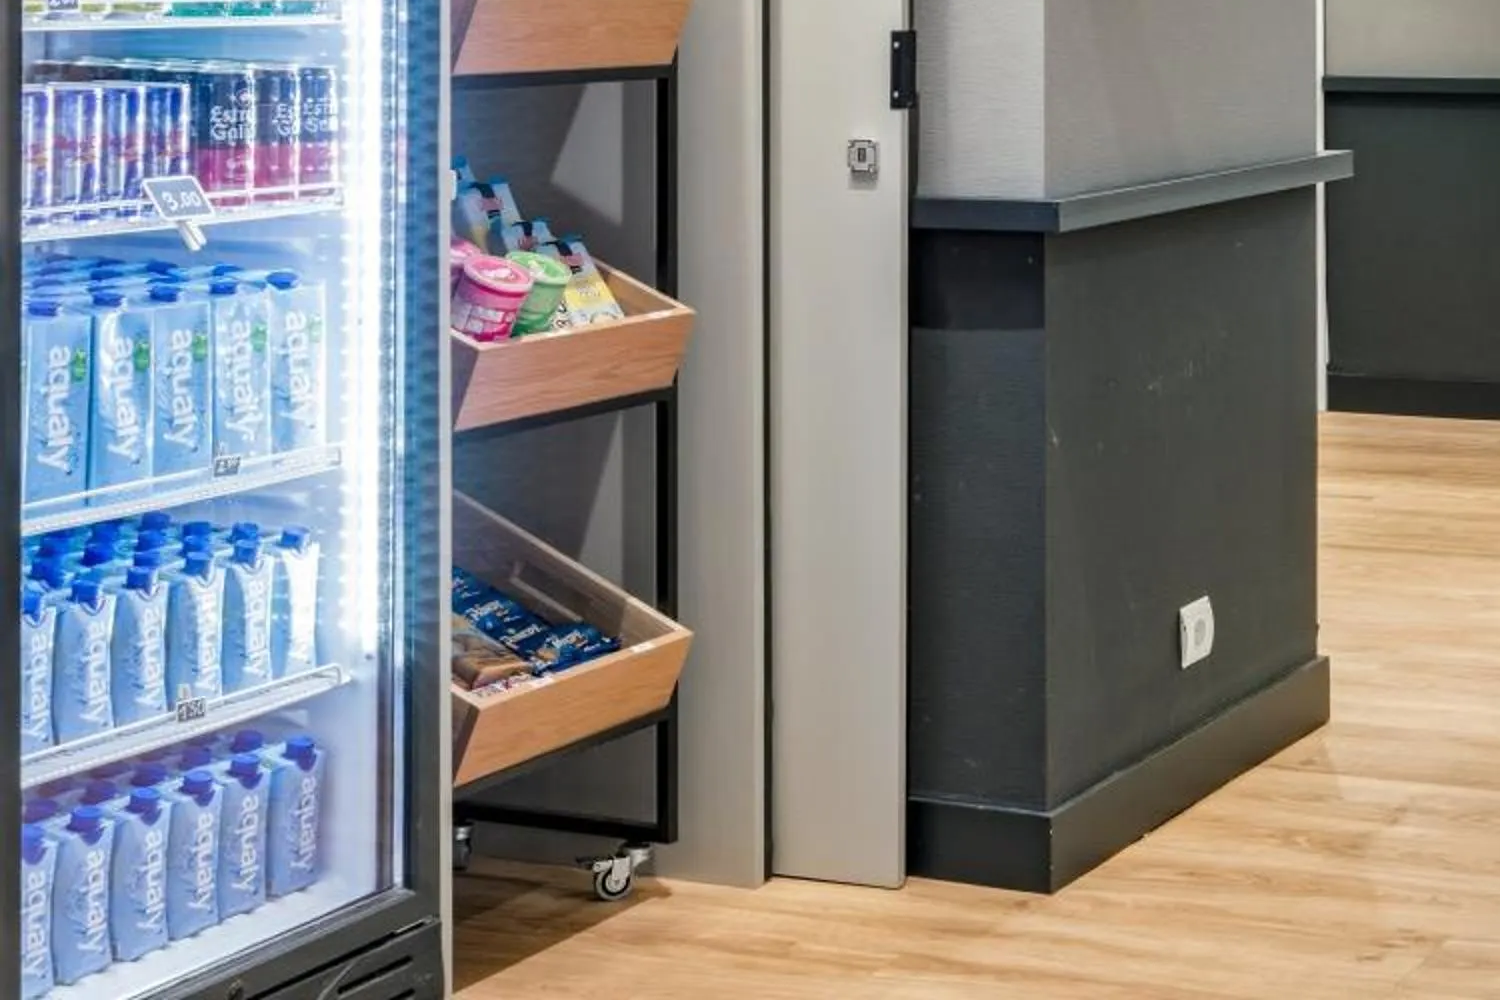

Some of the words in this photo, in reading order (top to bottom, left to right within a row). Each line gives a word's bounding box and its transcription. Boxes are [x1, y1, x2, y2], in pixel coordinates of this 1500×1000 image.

[37, 344, 73, 472] aqualy
[108, 336, 140, 459] aqualy
[163, 329, 198, 449] aqualy
[187, 812, 216, 911] aqualy
[231, 795, 260, 891] aqualy
[290, 777, 317, 870] aqualy
[22, 871, 48, 977] aqualy
[77, 850, 107, 951] aqualy
[137, 829, 166, 931] aqualy
